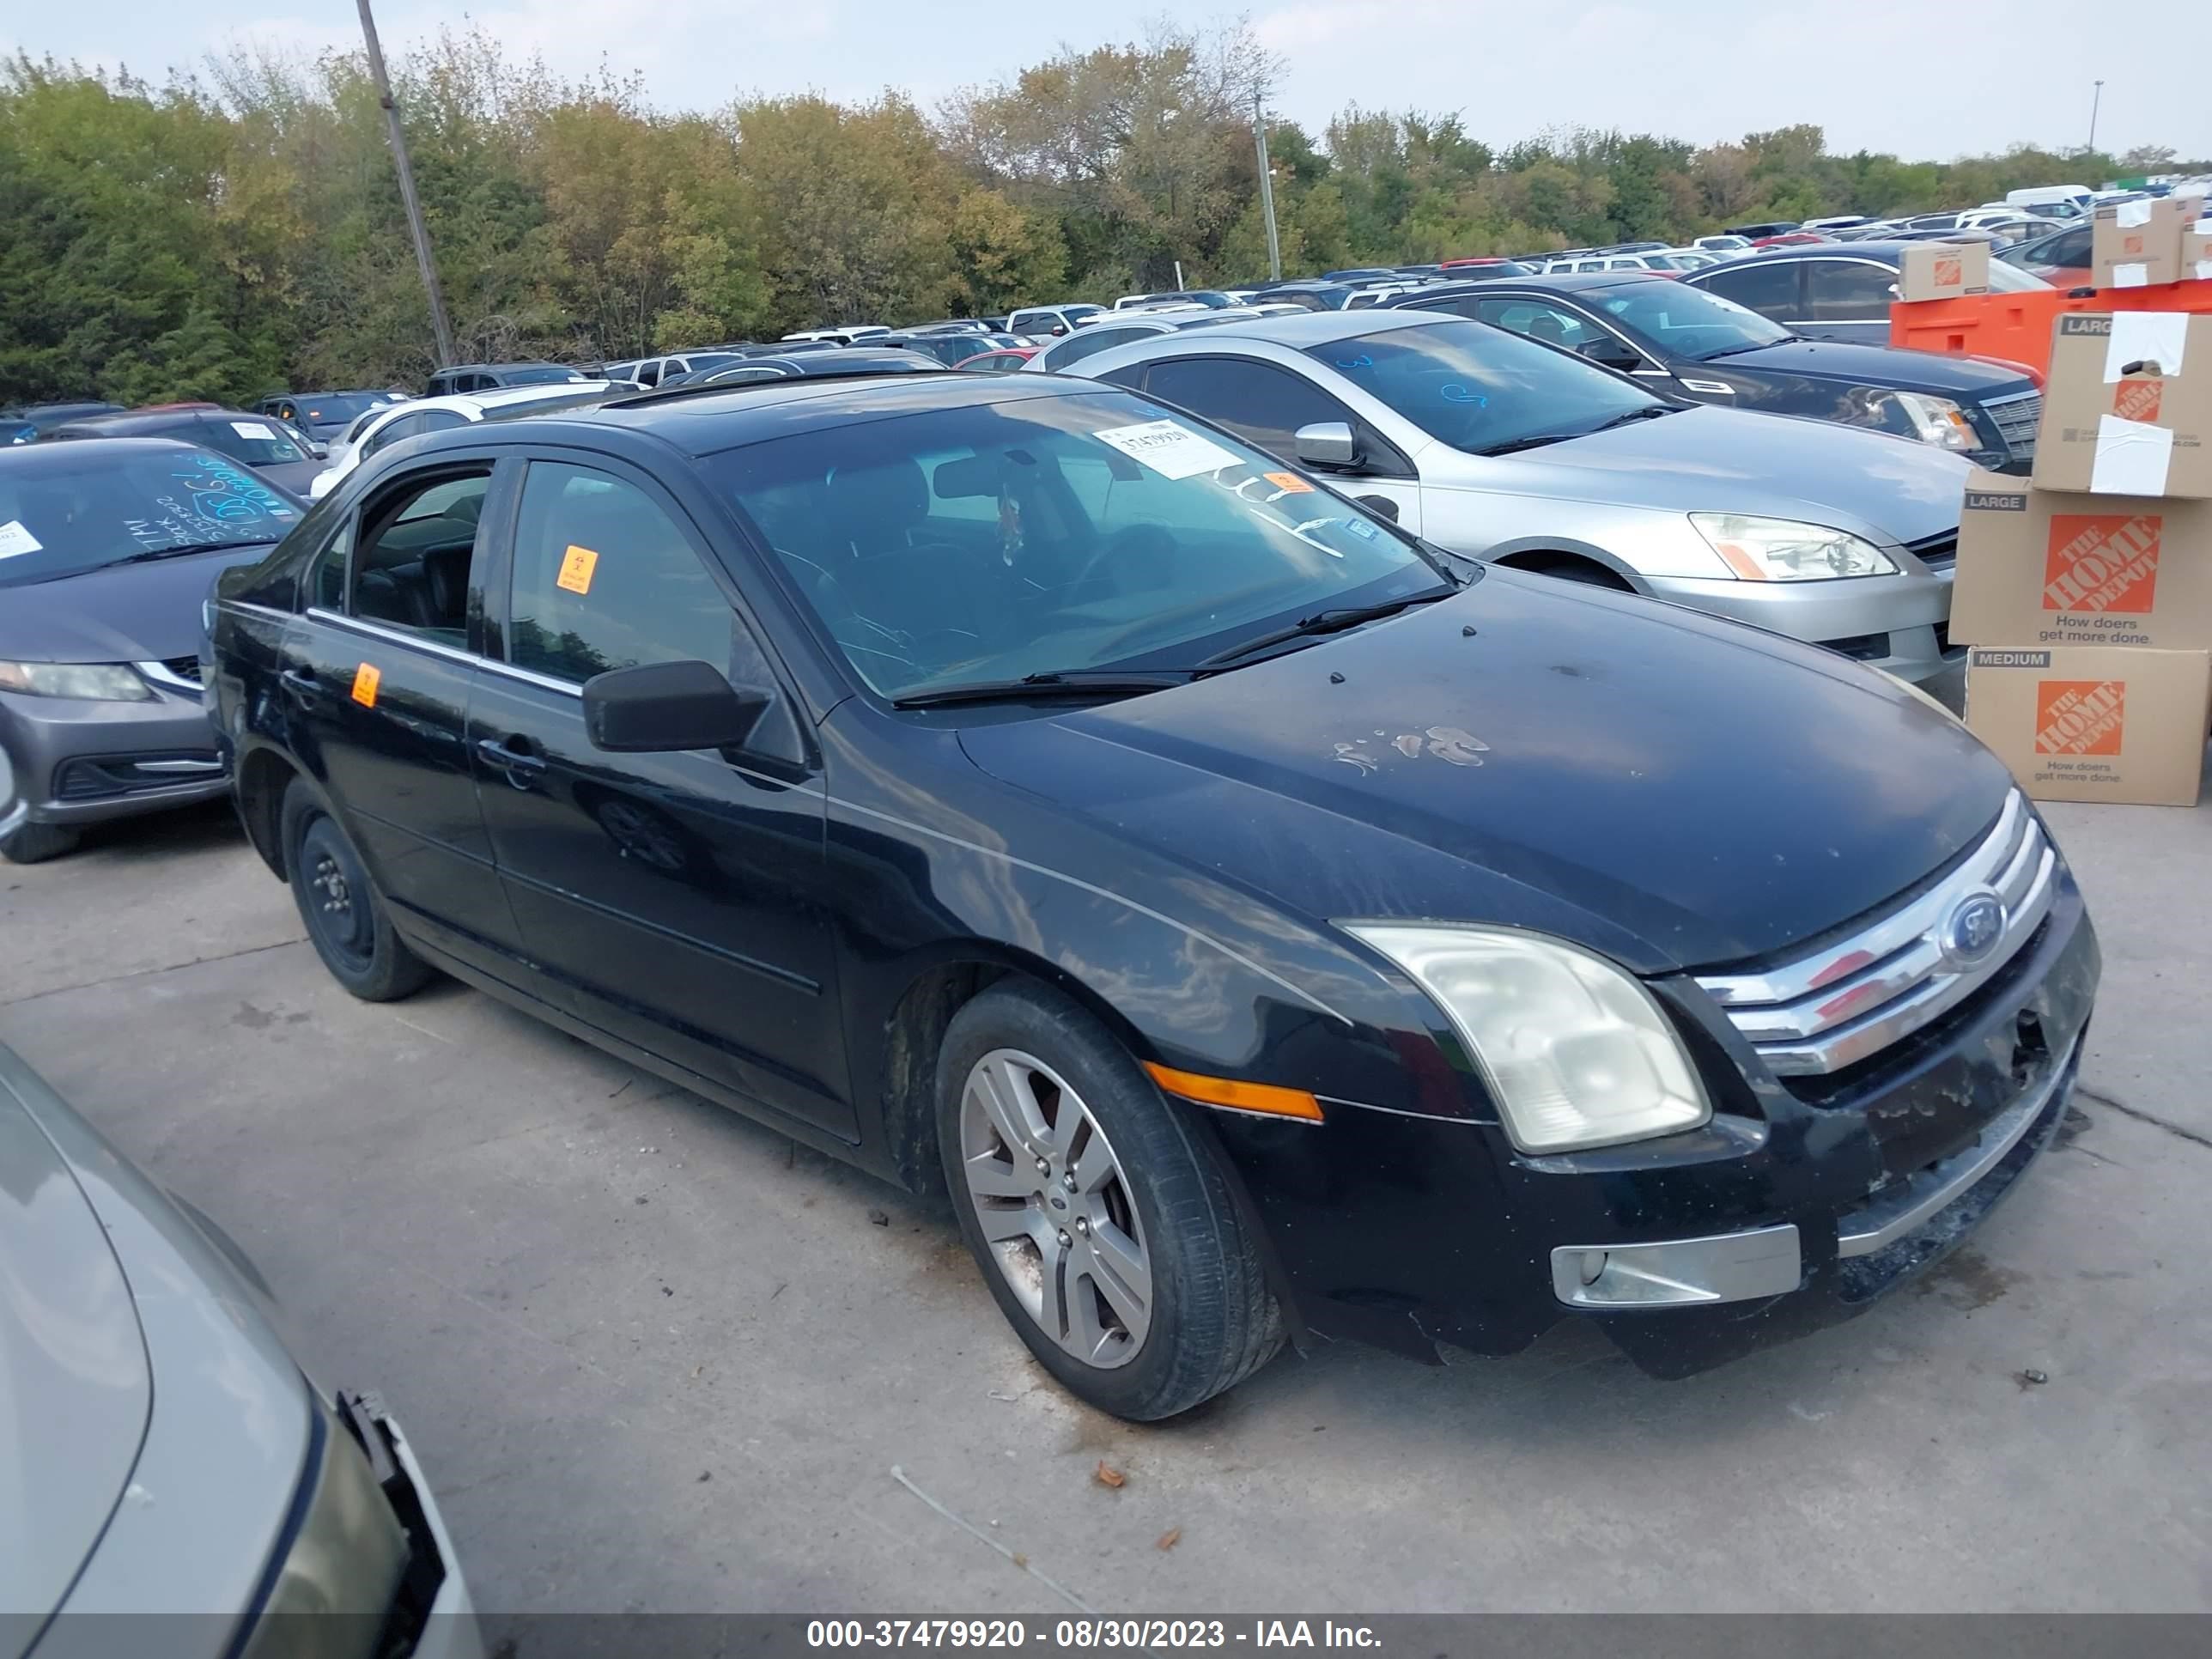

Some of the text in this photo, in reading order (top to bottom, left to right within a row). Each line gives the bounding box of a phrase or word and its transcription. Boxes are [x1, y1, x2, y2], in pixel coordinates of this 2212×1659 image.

[2068, 319, 2112, 333] LARG
[1121, 430, 1190, 451] 37479920
[1969, 495, 2021, 509] LARGE
[2057, 525, 2106, 562] THE
[2044, 515, 2160, 611] HOME
[2087, 550, 2157, 612] DEPOT
[2056, 615, 2137, 629] How doers
[2039, 629, 2154, 645] get more done.
[1978, 653, 2045, 667] MEDIUM
[2045, 688, 2083, 718] THE
[2035, 682, 2124, 755] HOME
[2069, 708, 2124, 755] DEPOT
[2047, 761, 2112, 772] How doers
[2034, 772, 2055, 782] get
[2057, 773, 2087, 781] more
